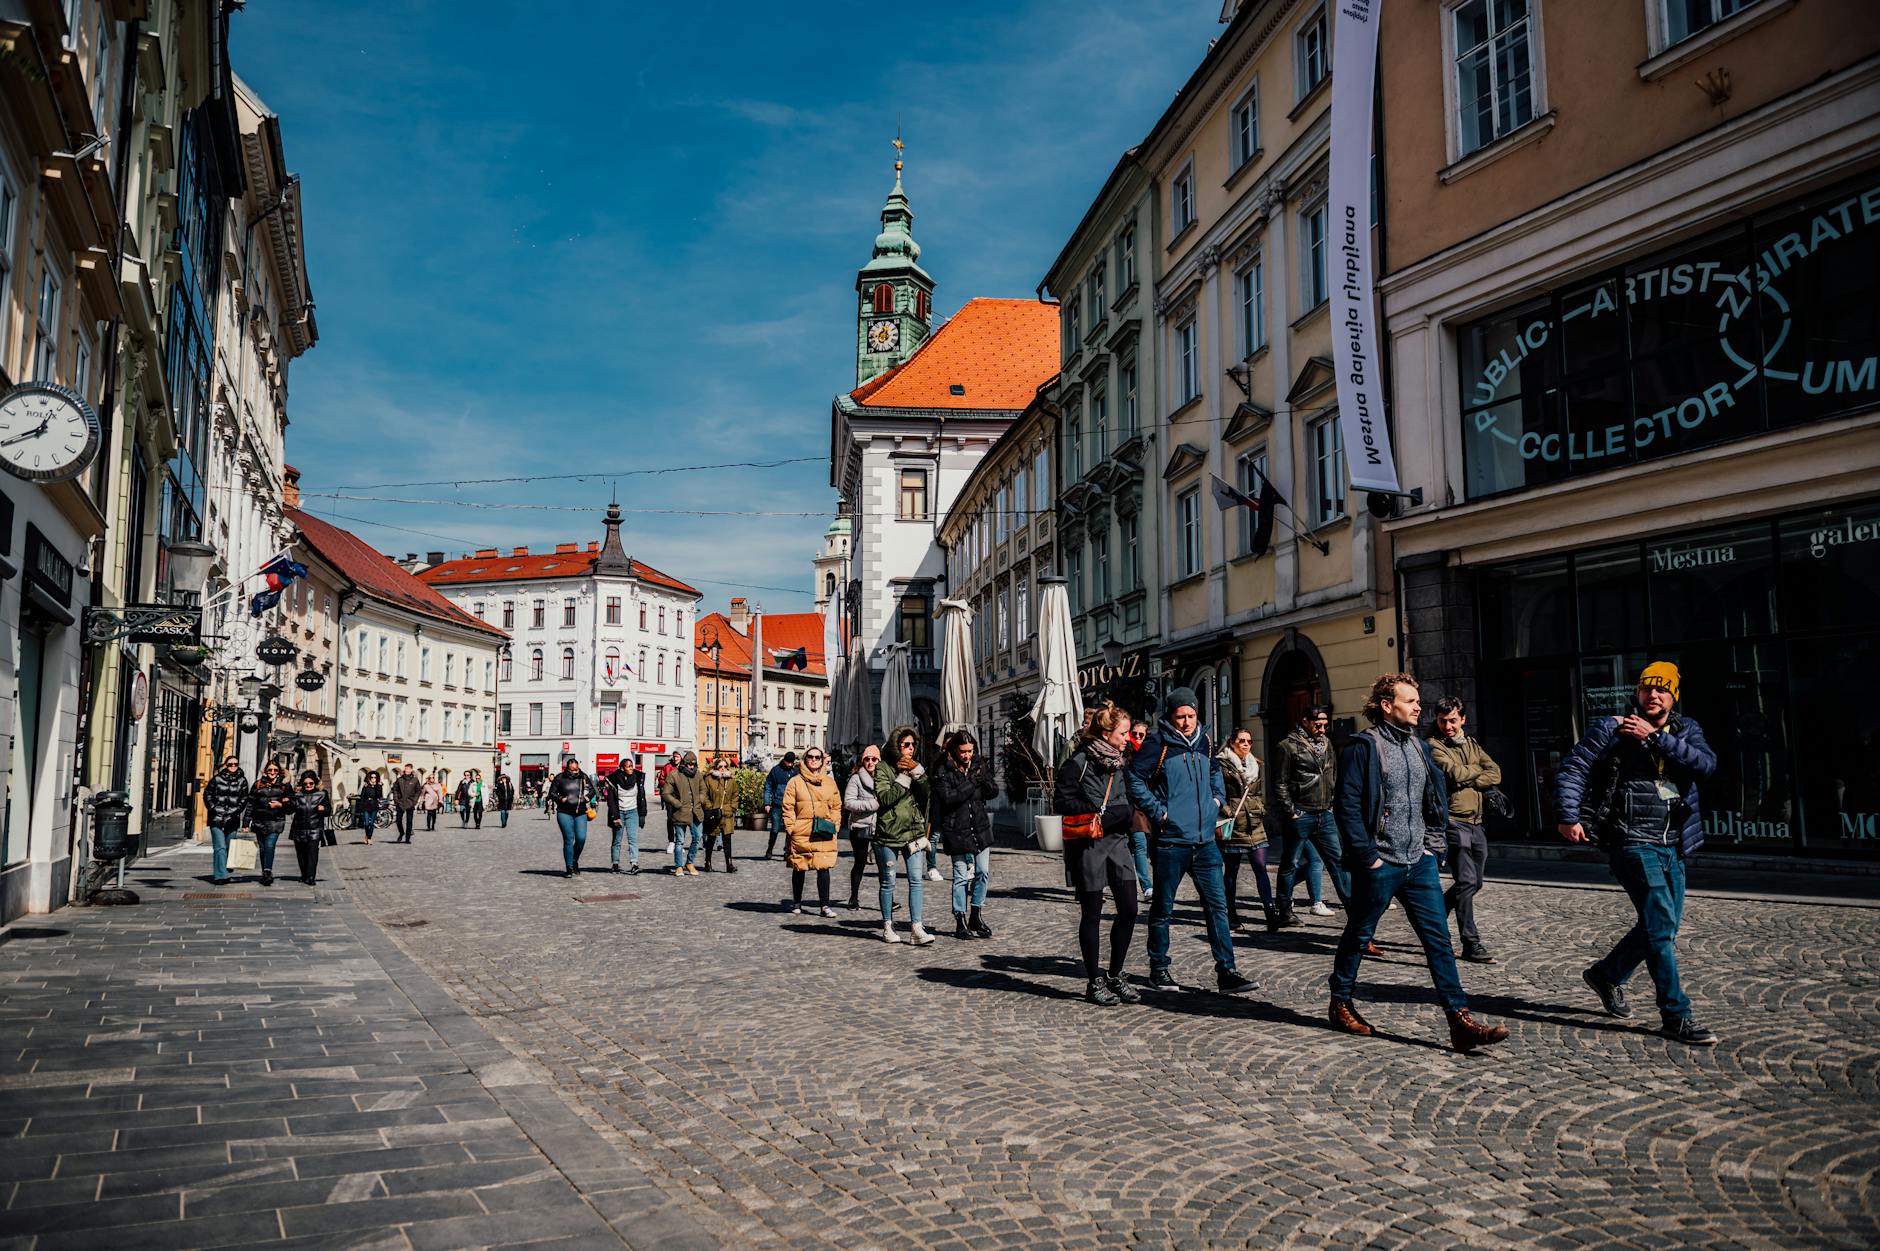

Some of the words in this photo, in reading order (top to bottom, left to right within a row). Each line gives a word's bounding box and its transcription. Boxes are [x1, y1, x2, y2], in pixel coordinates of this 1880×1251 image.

[1472, 320, 1550, 432] PUBLIC
[1590, 261, 1721, 319] ARTIST
[1801, 357, 1878, 396] UM
[1518, 381, 1736, 461] COLLECTOR
[1652, 544, 1737, 573] Mestna
[257, 647, 296, 655] IKONA
[1077, 652, 1142, 690] OTOVŽ
